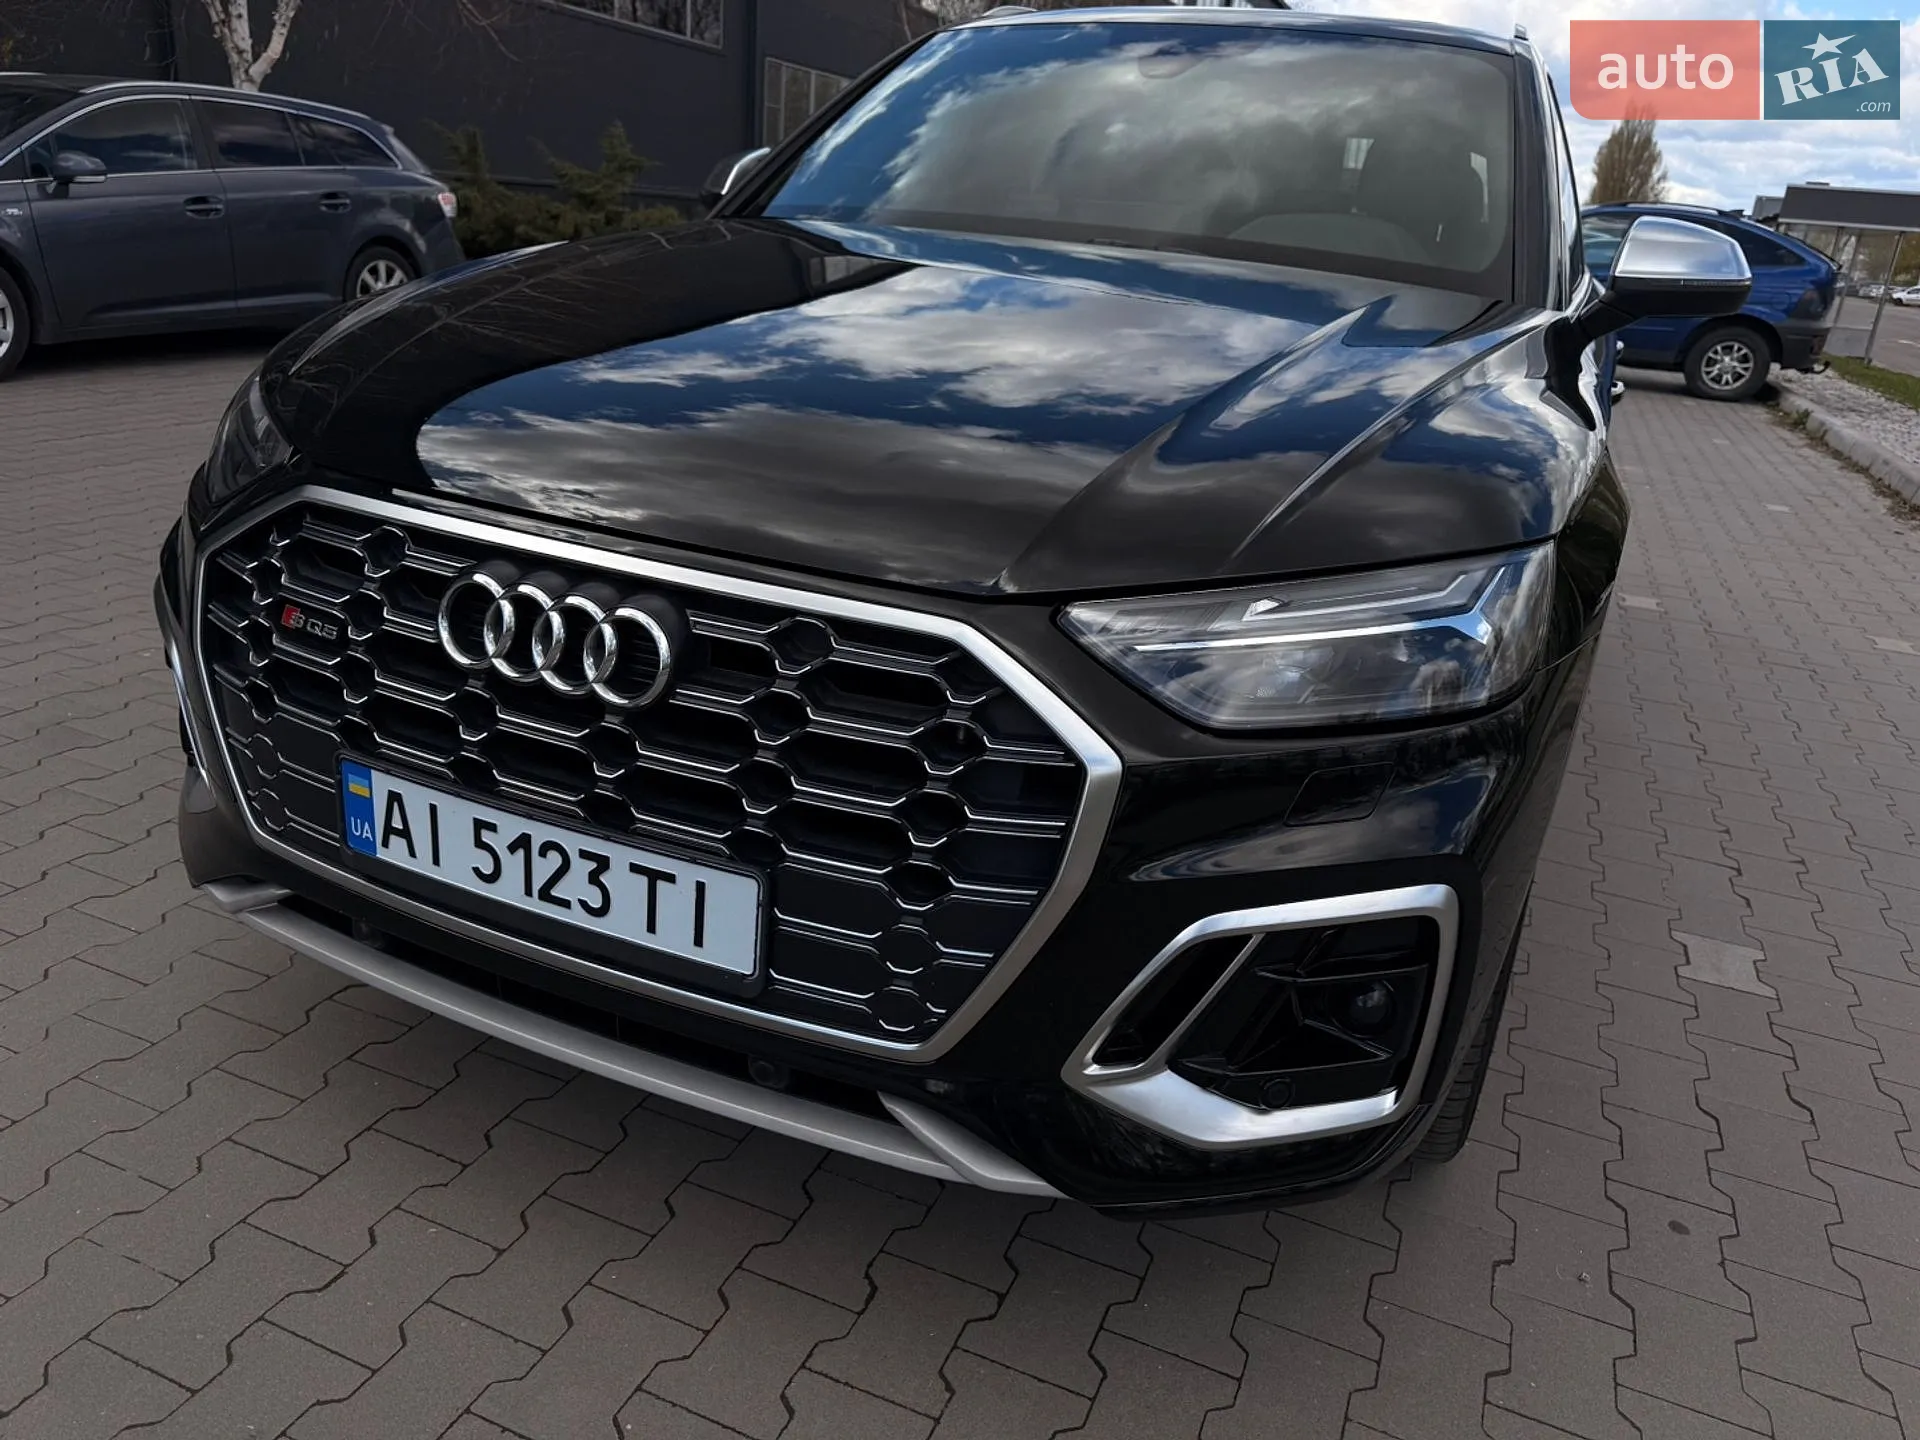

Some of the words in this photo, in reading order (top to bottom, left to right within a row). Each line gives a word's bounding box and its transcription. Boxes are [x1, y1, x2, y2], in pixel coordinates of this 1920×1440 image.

[351, 815, 374, 842] UA
[381, 789, 441, 867] AI
[471, 816, 611, 918] 5123
[629, 861, 706, 948] TI
